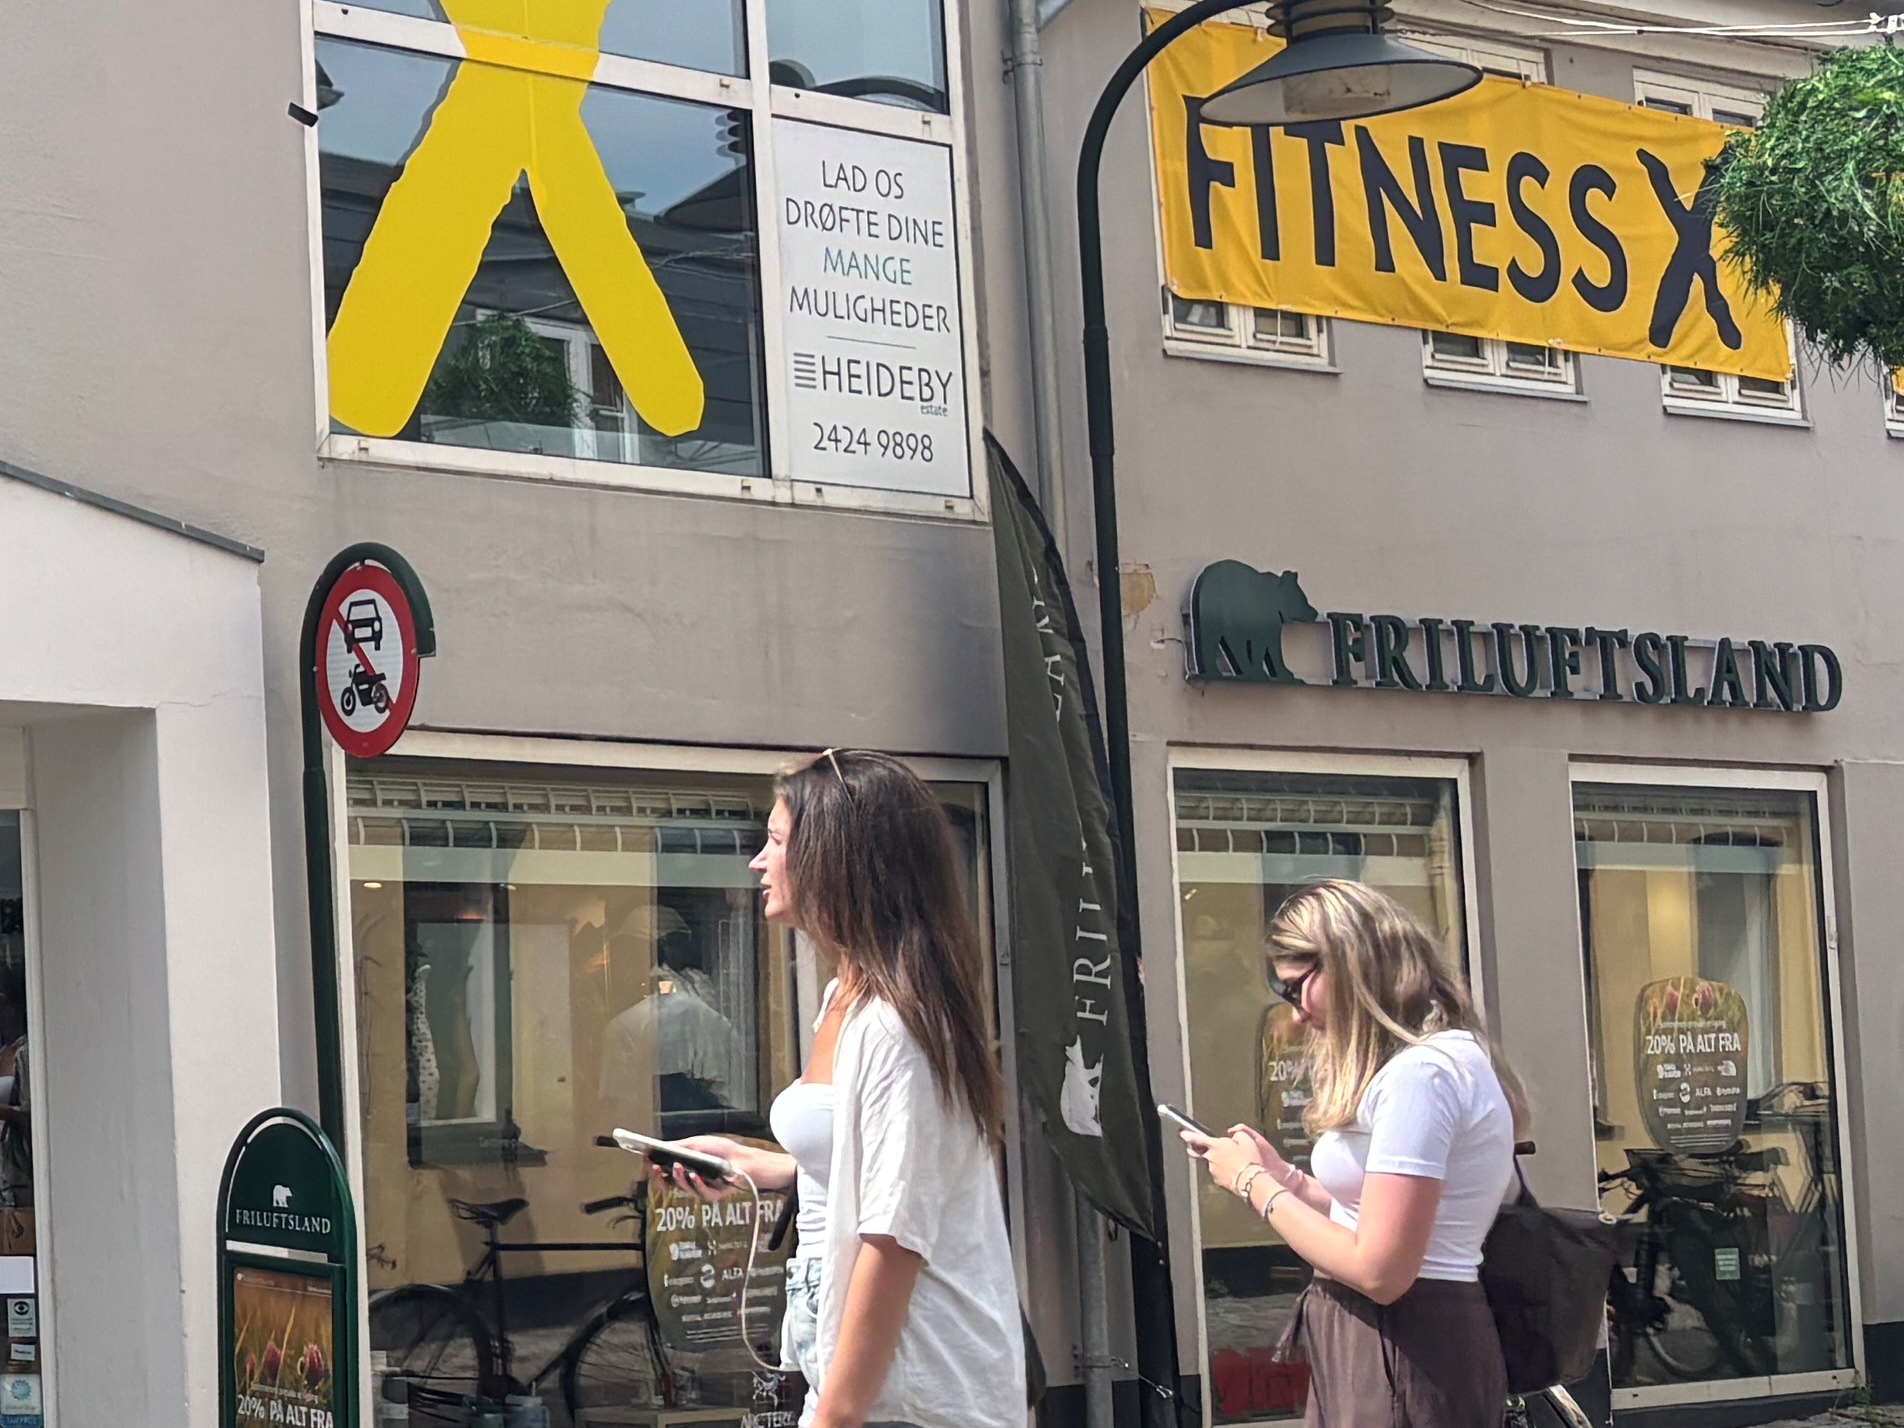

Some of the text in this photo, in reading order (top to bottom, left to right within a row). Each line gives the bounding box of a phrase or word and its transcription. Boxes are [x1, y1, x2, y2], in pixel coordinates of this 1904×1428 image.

[821, 159, 905, 200] LAD OS
[785, 197, 945, 249] DRØFTE DINE
[822, 246, 913, 286] MANGE
[789, 285, 951, 334] MULIGHEDER
[821, 354, 953, 406] HEIDEBY
[920, 404, 949, 418] estate
[812, 421, 935, 463] 2424 9898
[1326, 610, 1844, 714] FRILUFTSLAND
[1646, 1031, 1742, 1055] 20% PÅ ALT FRA
[235, 1208, 332, 1235] FRILUFTSLAND
[655, 1205, 695, 1232] 20%
[701, 1201, 723, 1227] PÅ
[725, 1201, 753, 1226] ALT
[237, 1394, 265, 1420] 20%
[269, 1399, 285, 1423] PÅ
[285, 1404, 309, 1427] ALT
